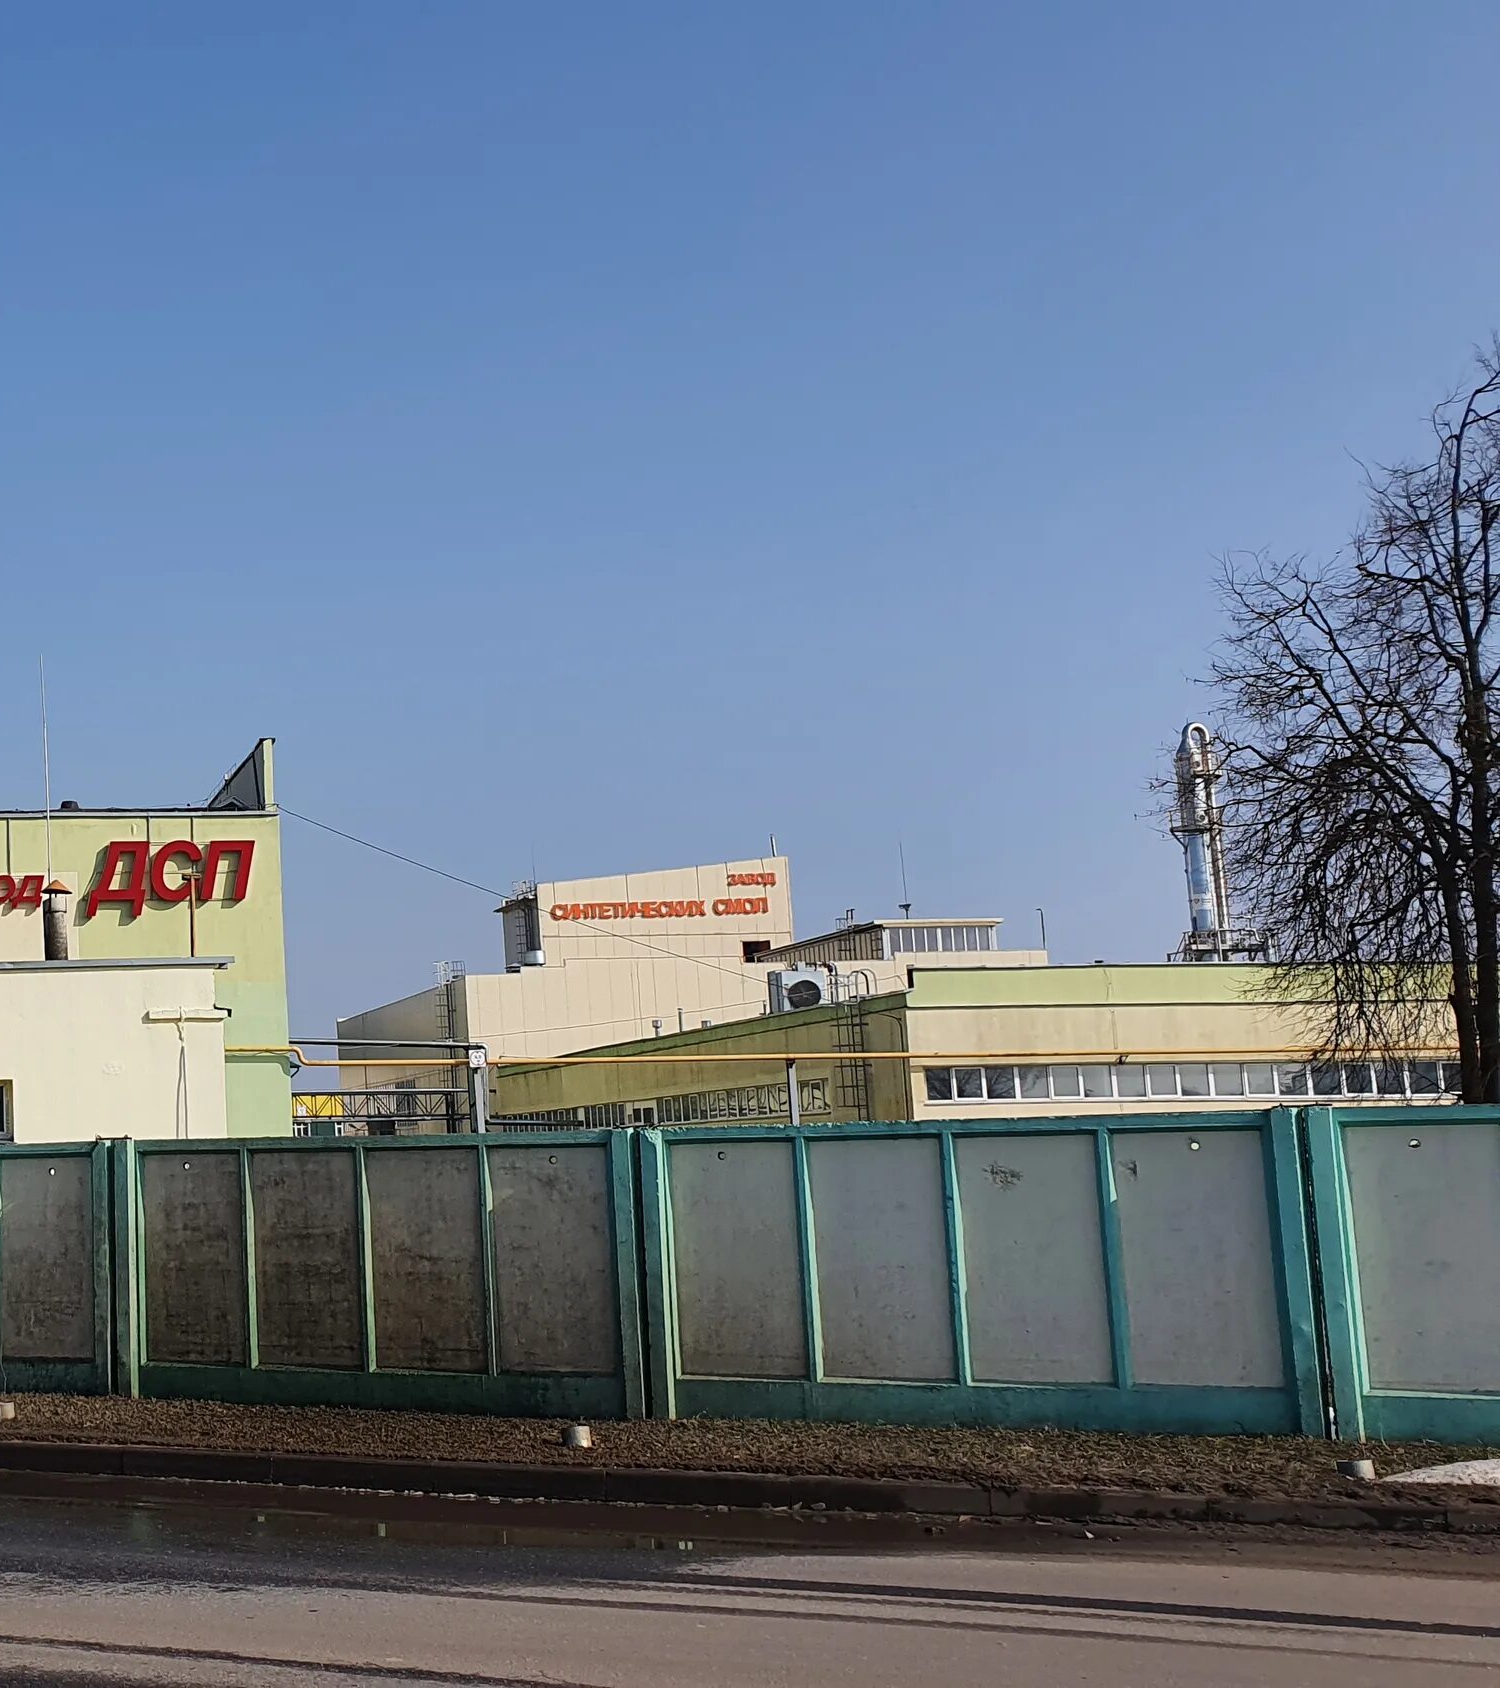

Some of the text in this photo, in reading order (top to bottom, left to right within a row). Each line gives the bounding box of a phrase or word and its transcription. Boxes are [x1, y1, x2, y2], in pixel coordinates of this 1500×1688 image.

[86, 840, 256, 917] ДСП
[727, 873, 776, 887] ЗАВОД
[550, 897, 768, 921] СИНТЕТИЧЕСКИХ СМОЛ
